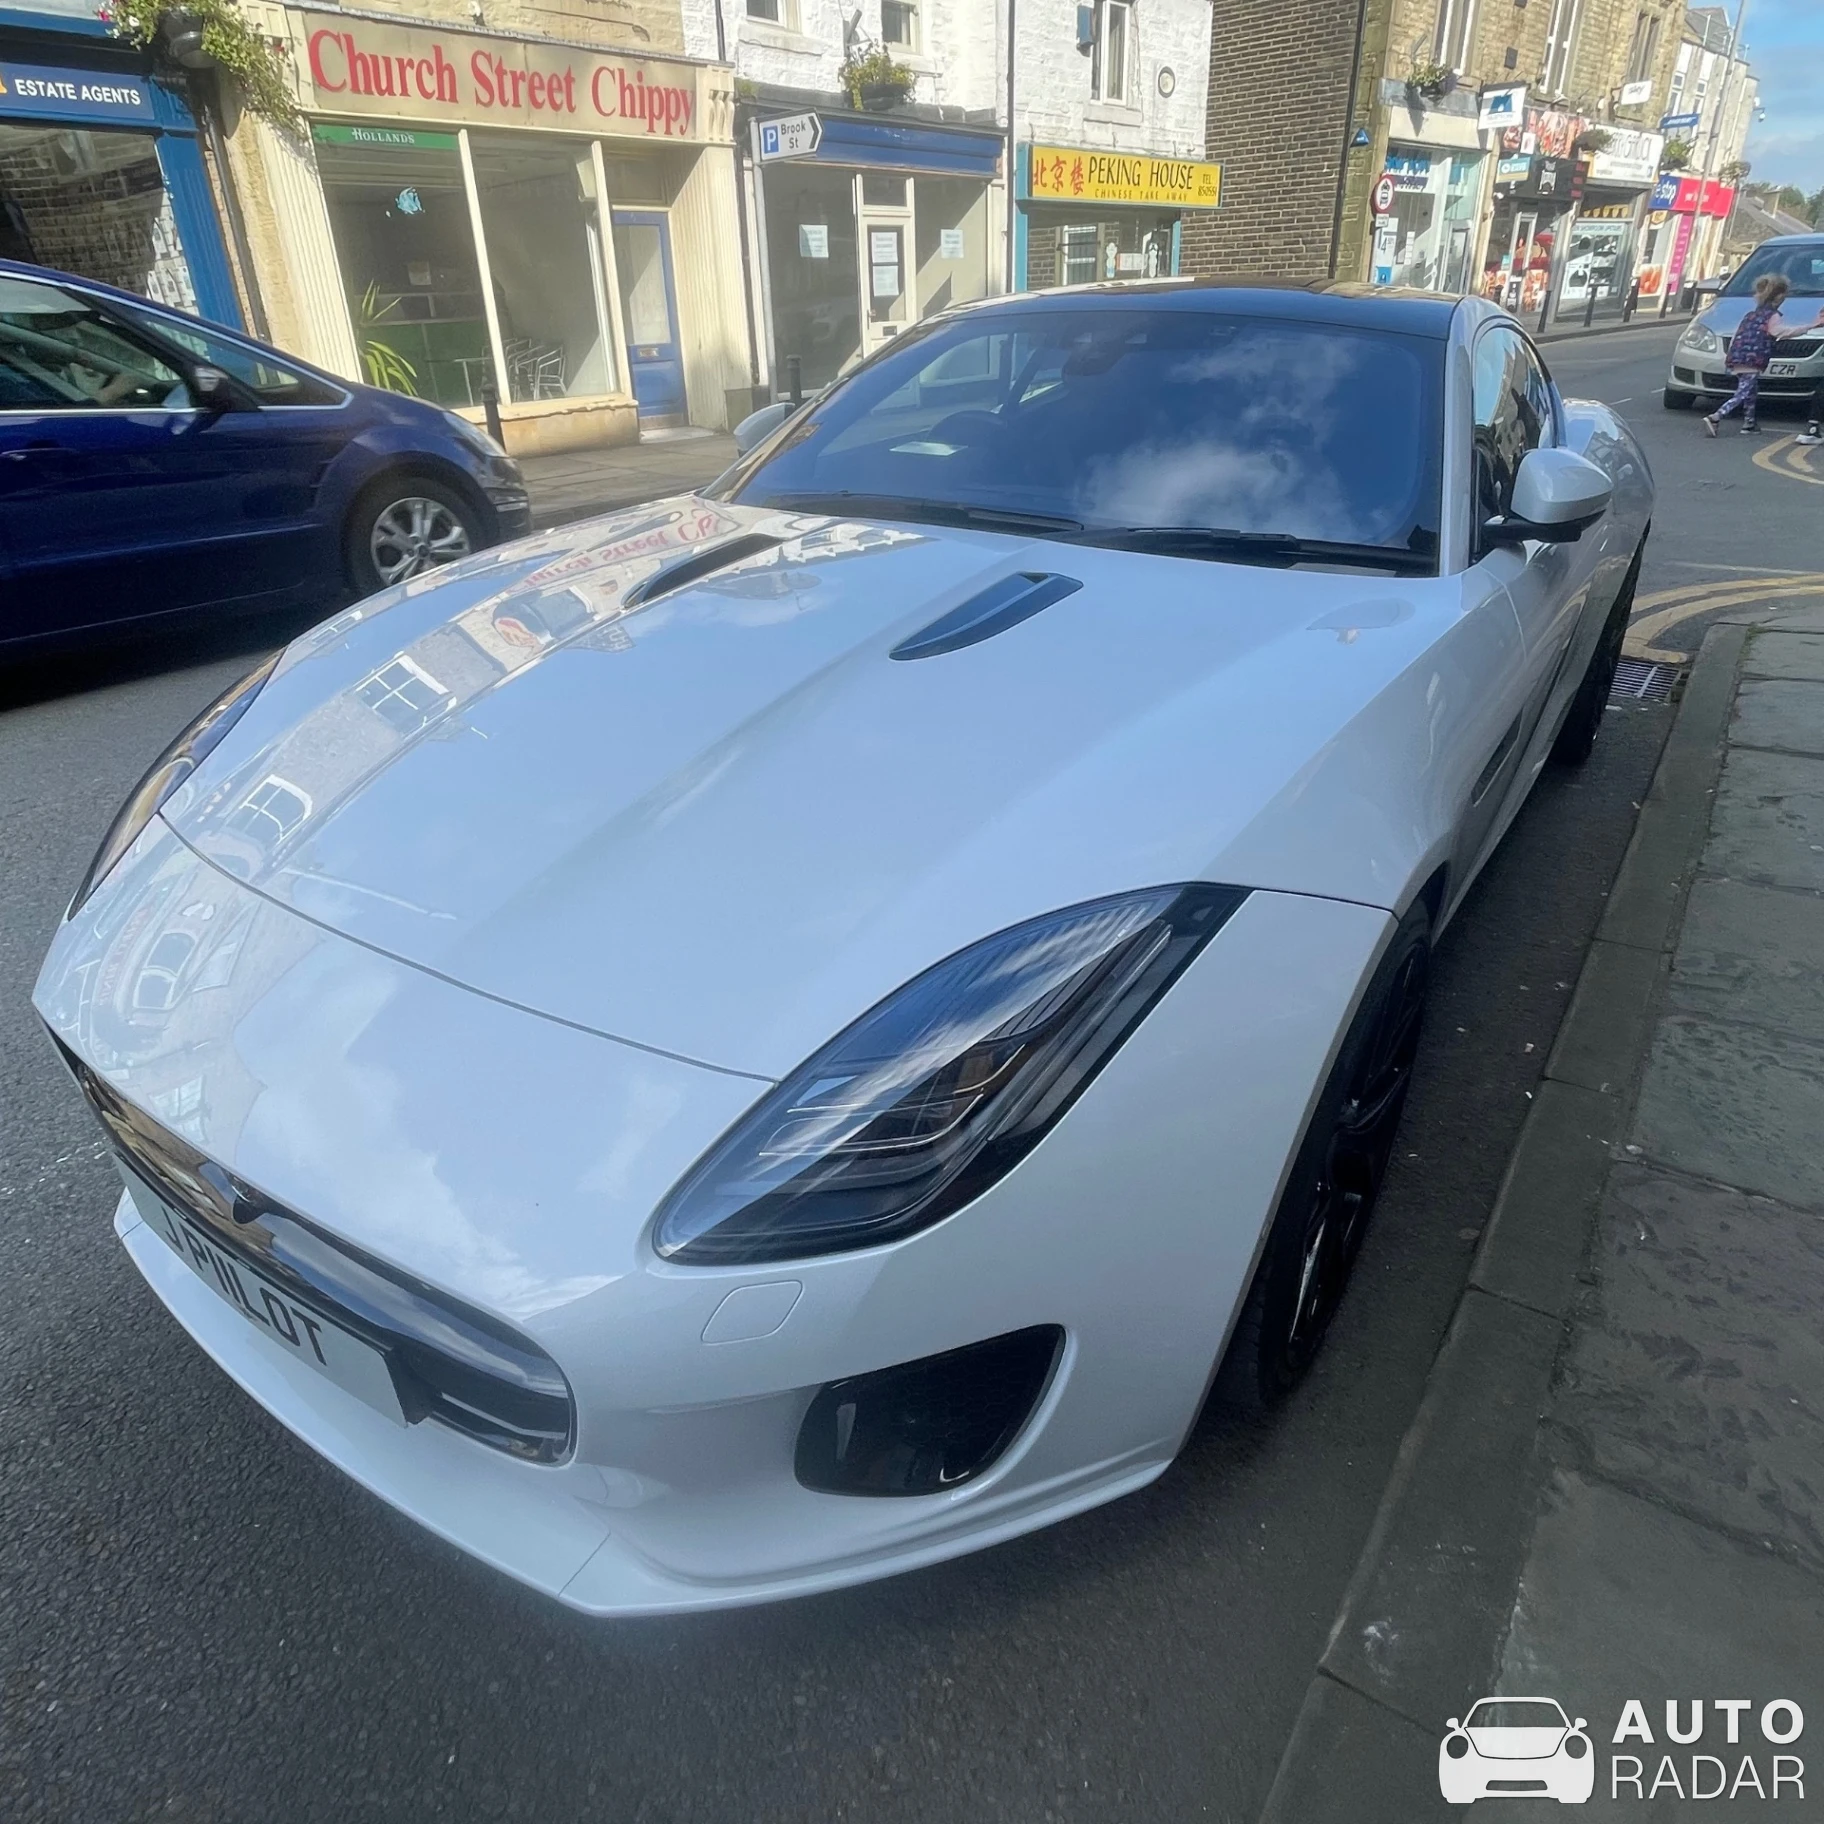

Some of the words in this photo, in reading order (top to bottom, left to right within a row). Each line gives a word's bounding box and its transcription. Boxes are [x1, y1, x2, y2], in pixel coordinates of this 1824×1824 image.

[308, 29, 457, 103] Church
[471, 49, 576, 113] Street
[591, 66, 694, 136] Chippy
[15, 78, 77, 100] ESTATE
[81, 85, 141, 106] AGENTS
[781, 120, 806, 135] Brook
[789, 137, 799, 149] St
[1088, 156, 1141, 187] PEKING
[1149, 161, 1194, 190] HOUSE
[1095, 188, 1132, 200] CHINESE
[1140, 190, 1159, 201] TAKE
[1166, 192, 1188, 202] AWAY
[1769, 364, 1797, 376] CZR
